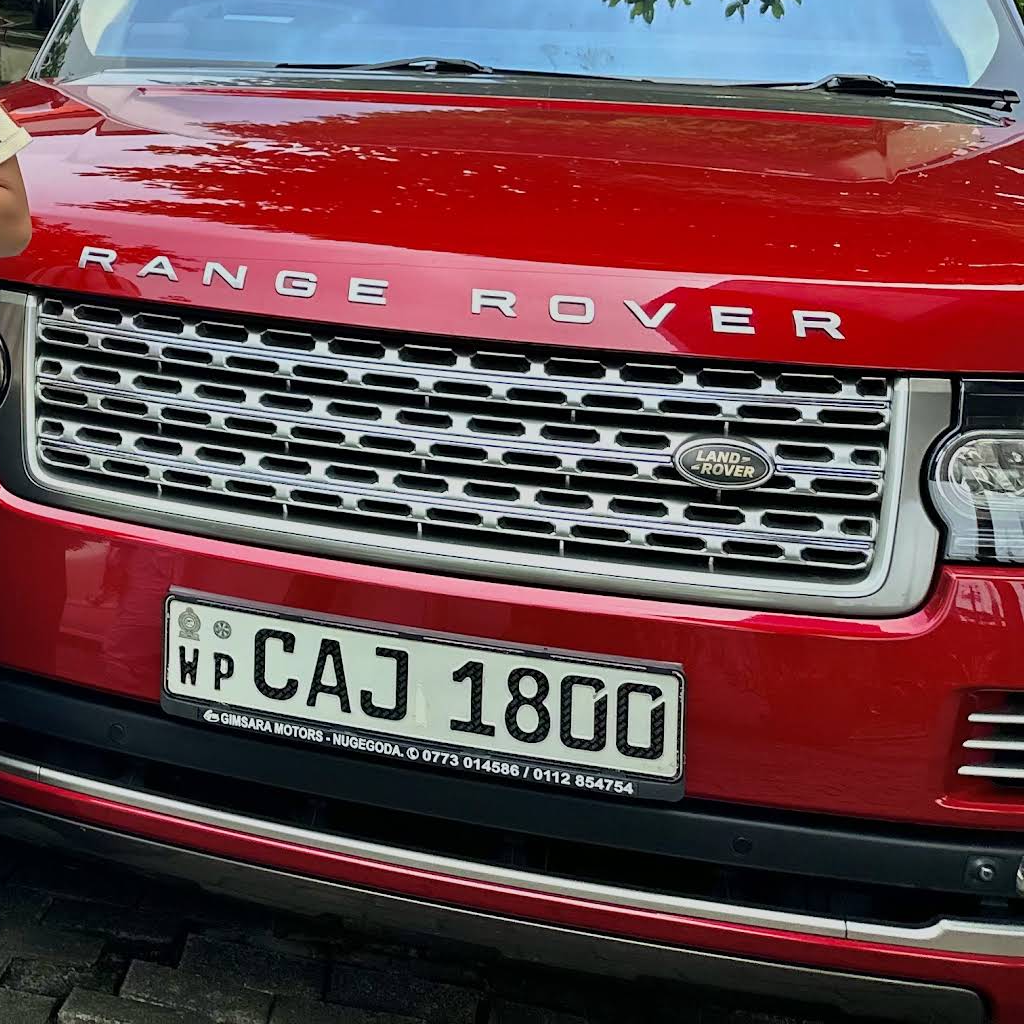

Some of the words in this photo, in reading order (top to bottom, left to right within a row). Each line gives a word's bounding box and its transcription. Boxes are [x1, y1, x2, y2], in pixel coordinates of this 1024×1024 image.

[77, 245, 389, 307] RANGE
[471, 289, 845, 341] ROVER
[695, 449, 741, 464] LAND
[700, 462, 756, 478] ROVER
[254, 628, 409, 721] CAJ
[450, 660, 665, 760] 1800
[220, 712, 273, 733] GIMSARA
[274, 722, 324, 743] MOTORS
[332, 733, 404, 758] NUGEGODA.
[422, 749, 460, 767] 0773
[463, 756, 520, 777] 014586
[533, 767, 571, 786] 0112
[575, 775, 635, 795] 854754
